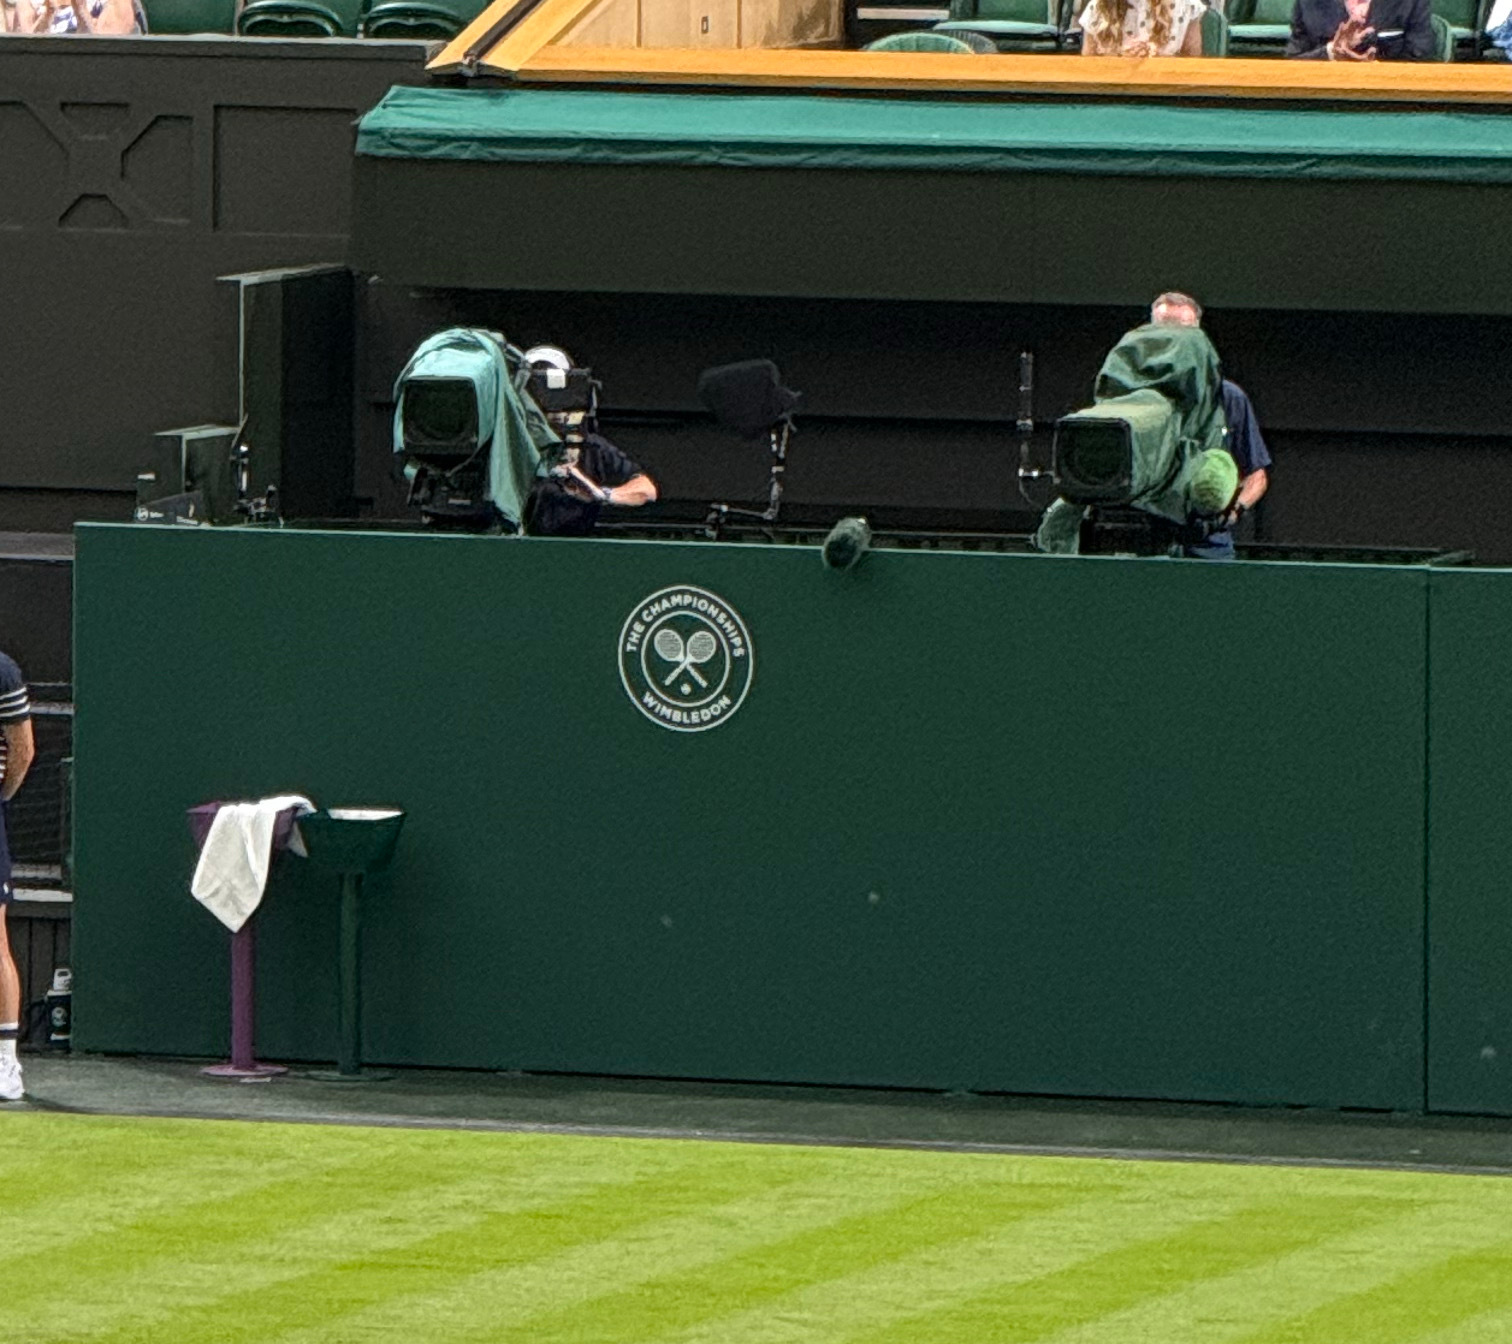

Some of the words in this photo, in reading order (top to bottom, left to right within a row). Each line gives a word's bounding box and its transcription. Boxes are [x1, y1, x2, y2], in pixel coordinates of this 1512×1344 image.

[626, 621, 646, 653] THE
[642, 594, 746, 657] CHAMPIONSHIPS
[642, 691, 732, 724] WIMBLEDON
